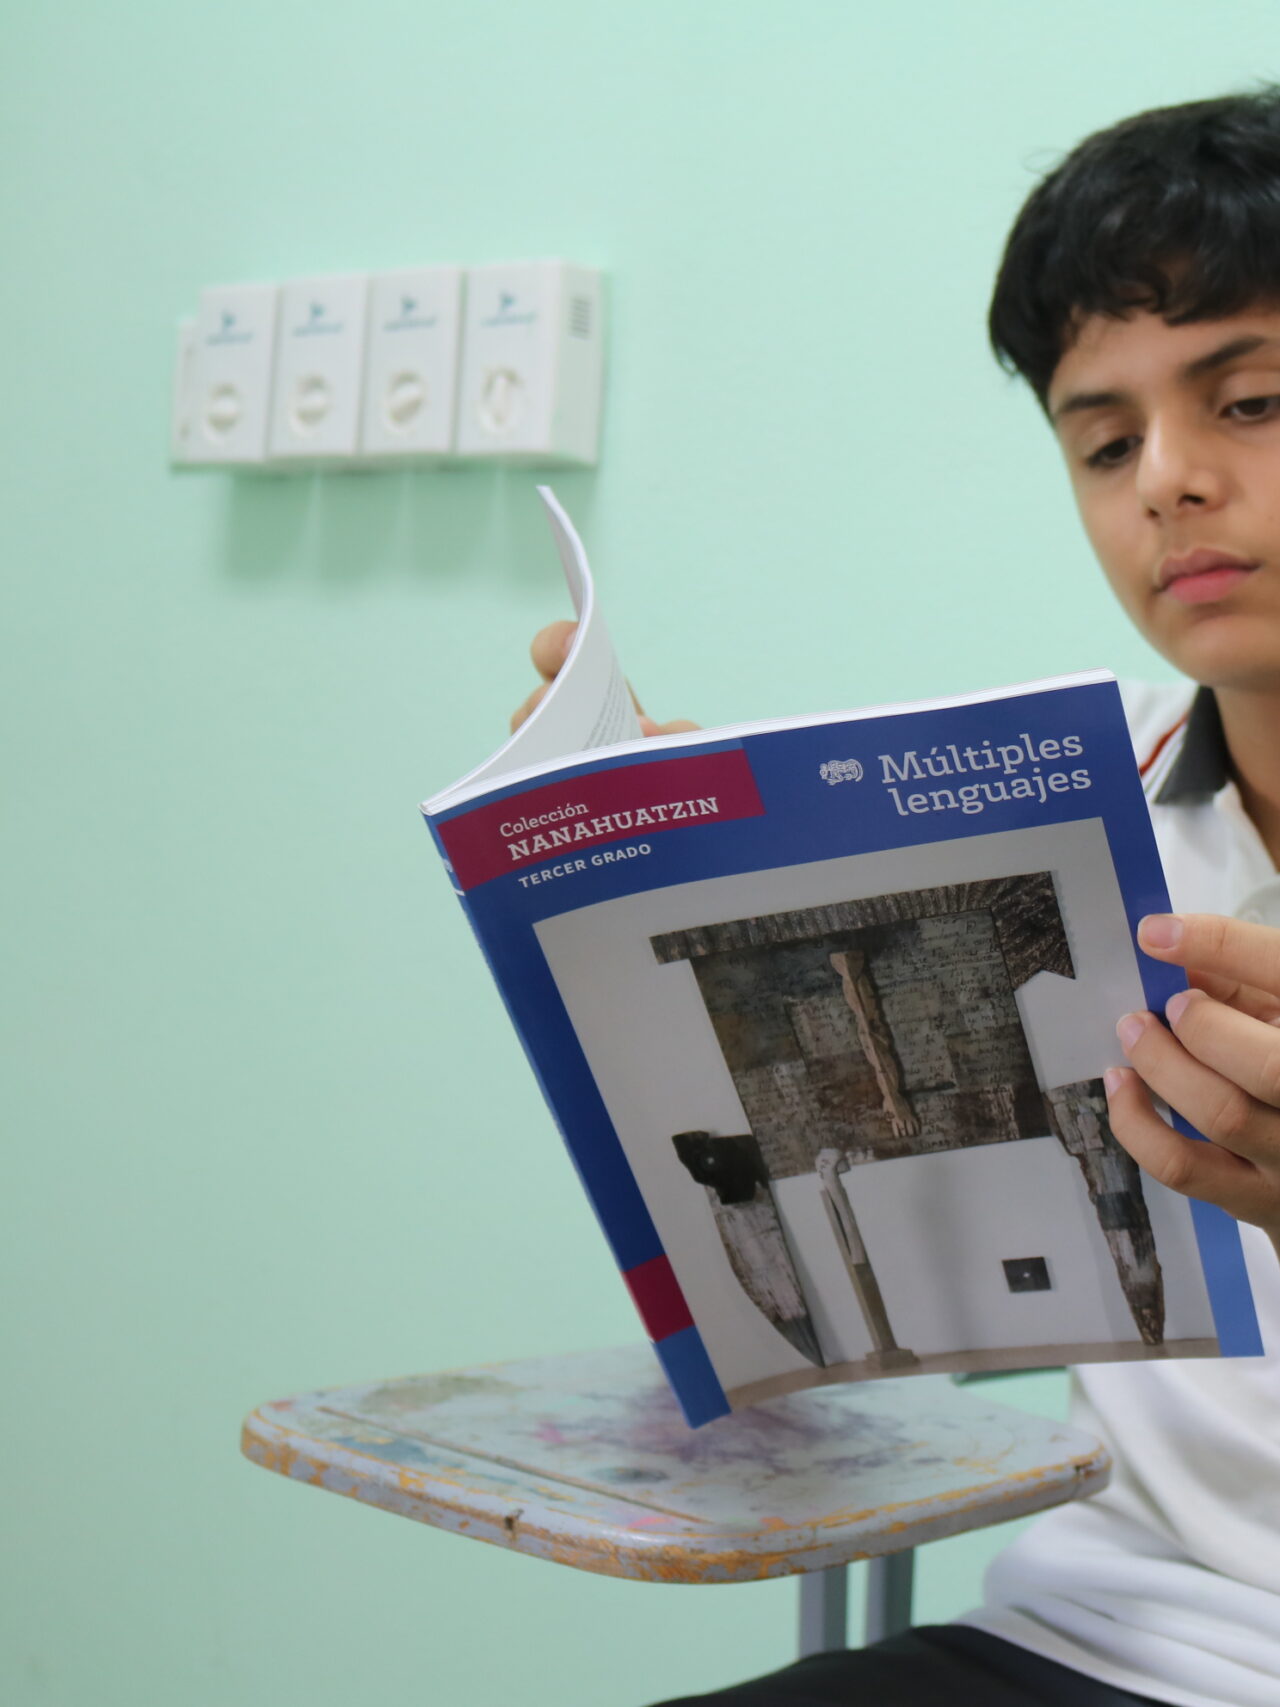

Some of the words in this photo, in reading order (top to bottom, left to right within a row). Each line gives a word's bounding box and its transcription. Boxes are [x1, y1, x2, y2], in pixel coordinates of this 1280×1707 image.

[878, 733, 1083, 784] Múltiples
[888, 768, 1092, 816] lenguajes
[500, 803, 589, 837] Colección
[507, 797, 719, 861] NANAHUATZIN
[519, 860, 587, 888] TERCER
[591, 844, 651, 866] GRADO
